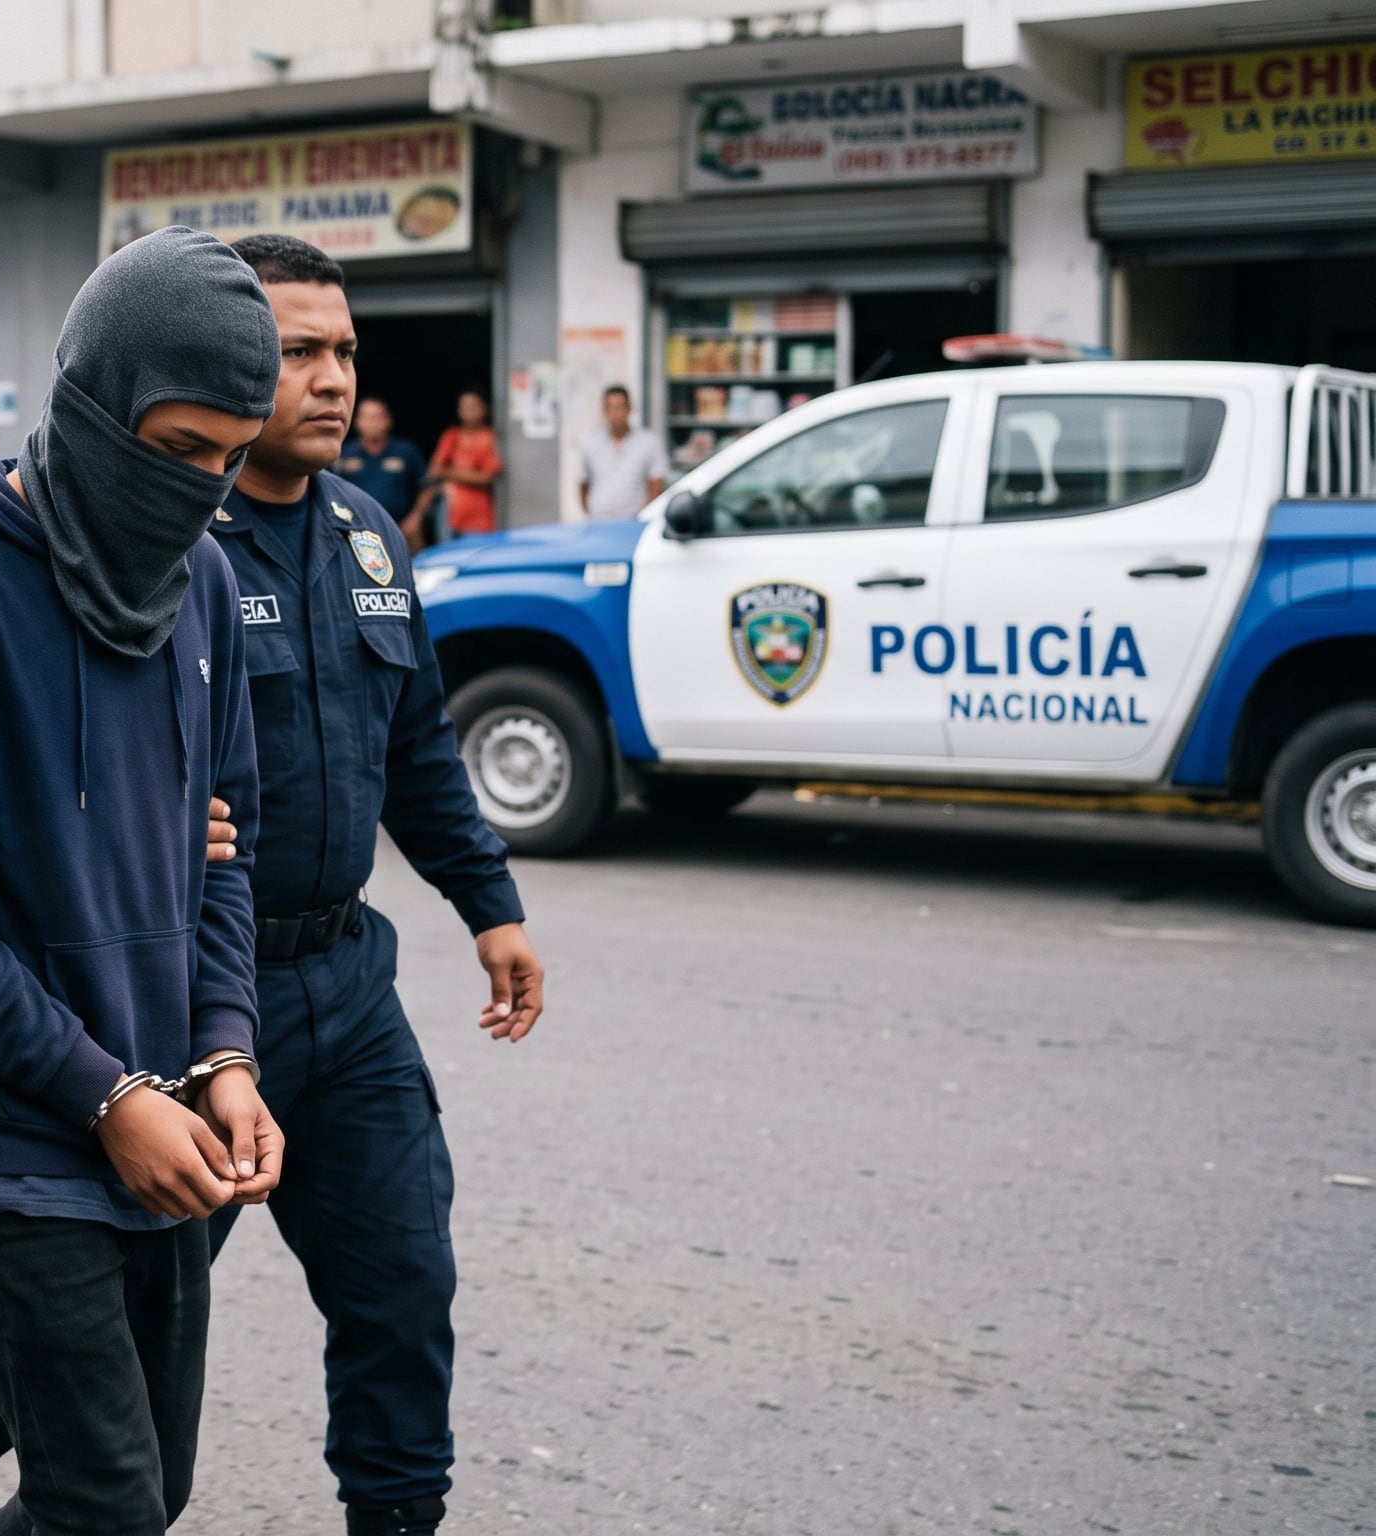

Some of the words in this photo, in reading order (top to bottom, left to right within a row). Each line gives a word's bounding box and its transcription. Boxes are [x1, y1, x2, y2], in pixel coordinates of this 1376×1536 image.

[1141, 52, 1376, 110] SELCHI
[1224, 111, 1263, 134] LA
[871, 608, 1148, 677] POLICÍA
[949, 694, 1149, 724] NACIONAL
